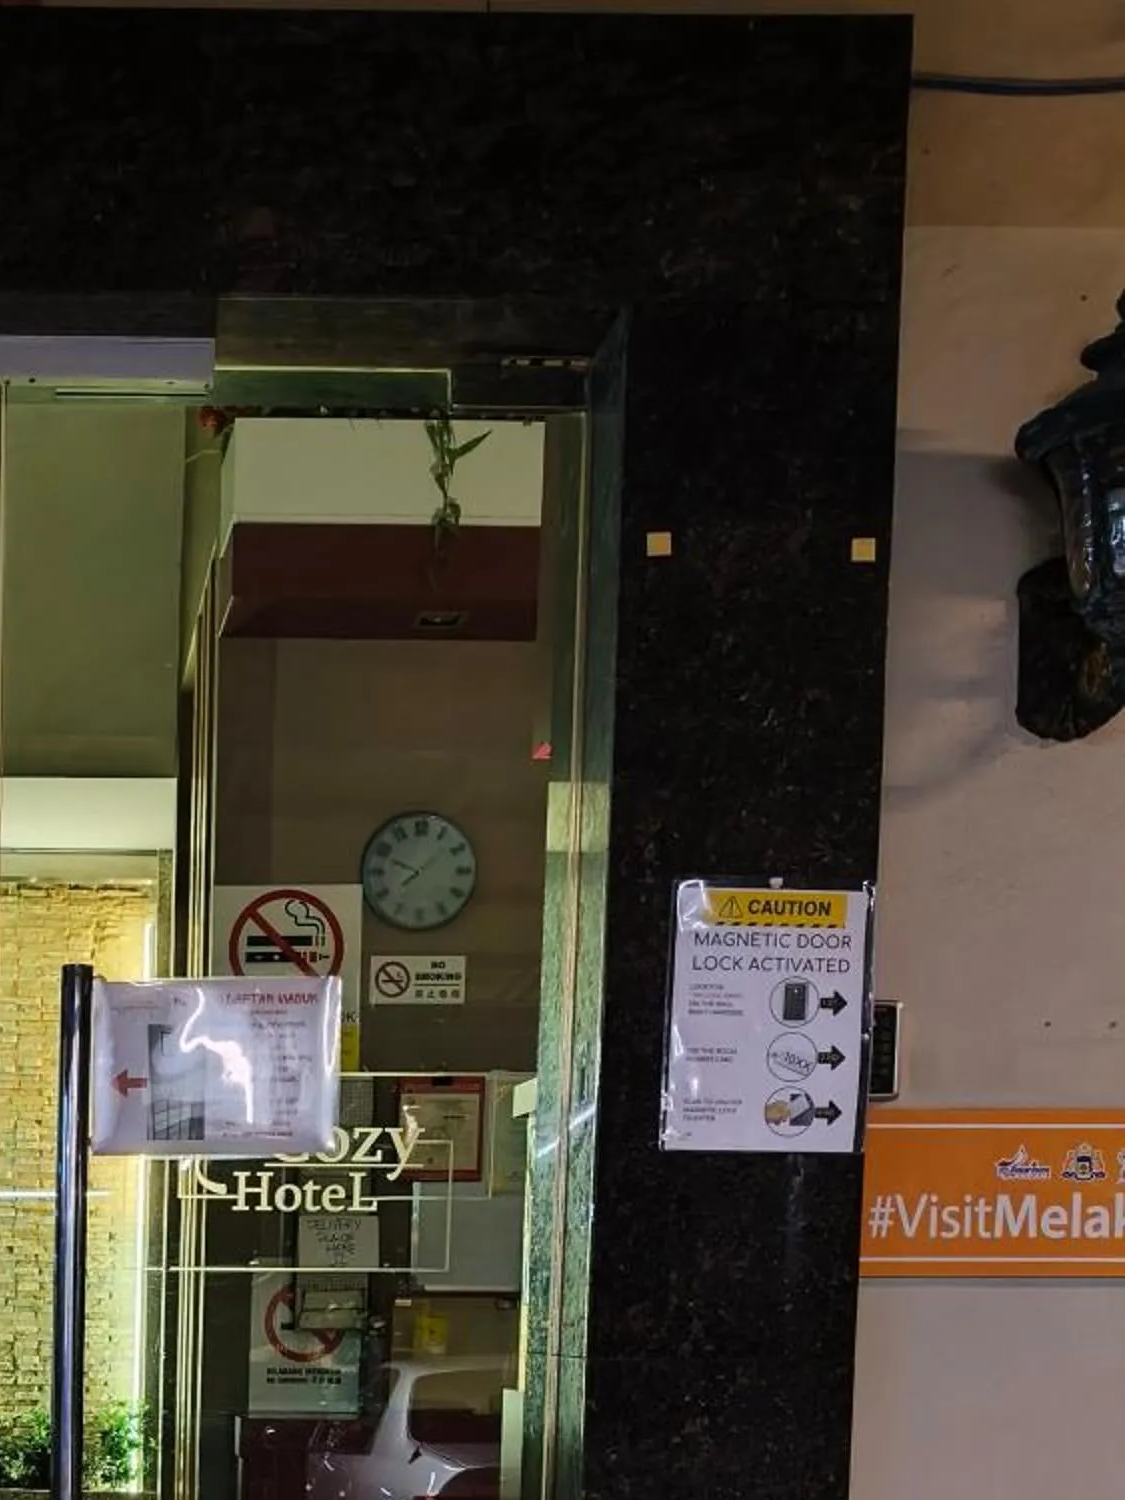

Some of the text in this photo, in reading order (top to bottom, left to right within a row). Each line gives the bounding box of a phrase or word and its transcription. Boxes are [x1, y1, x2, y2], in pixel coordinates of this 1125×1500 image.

[748, 899, 831, 916] CAUTION
[694, 931, 852, 949] MAGNETIC DOOR
[692, 955, 850, 973] LOCK ACTIVATED
